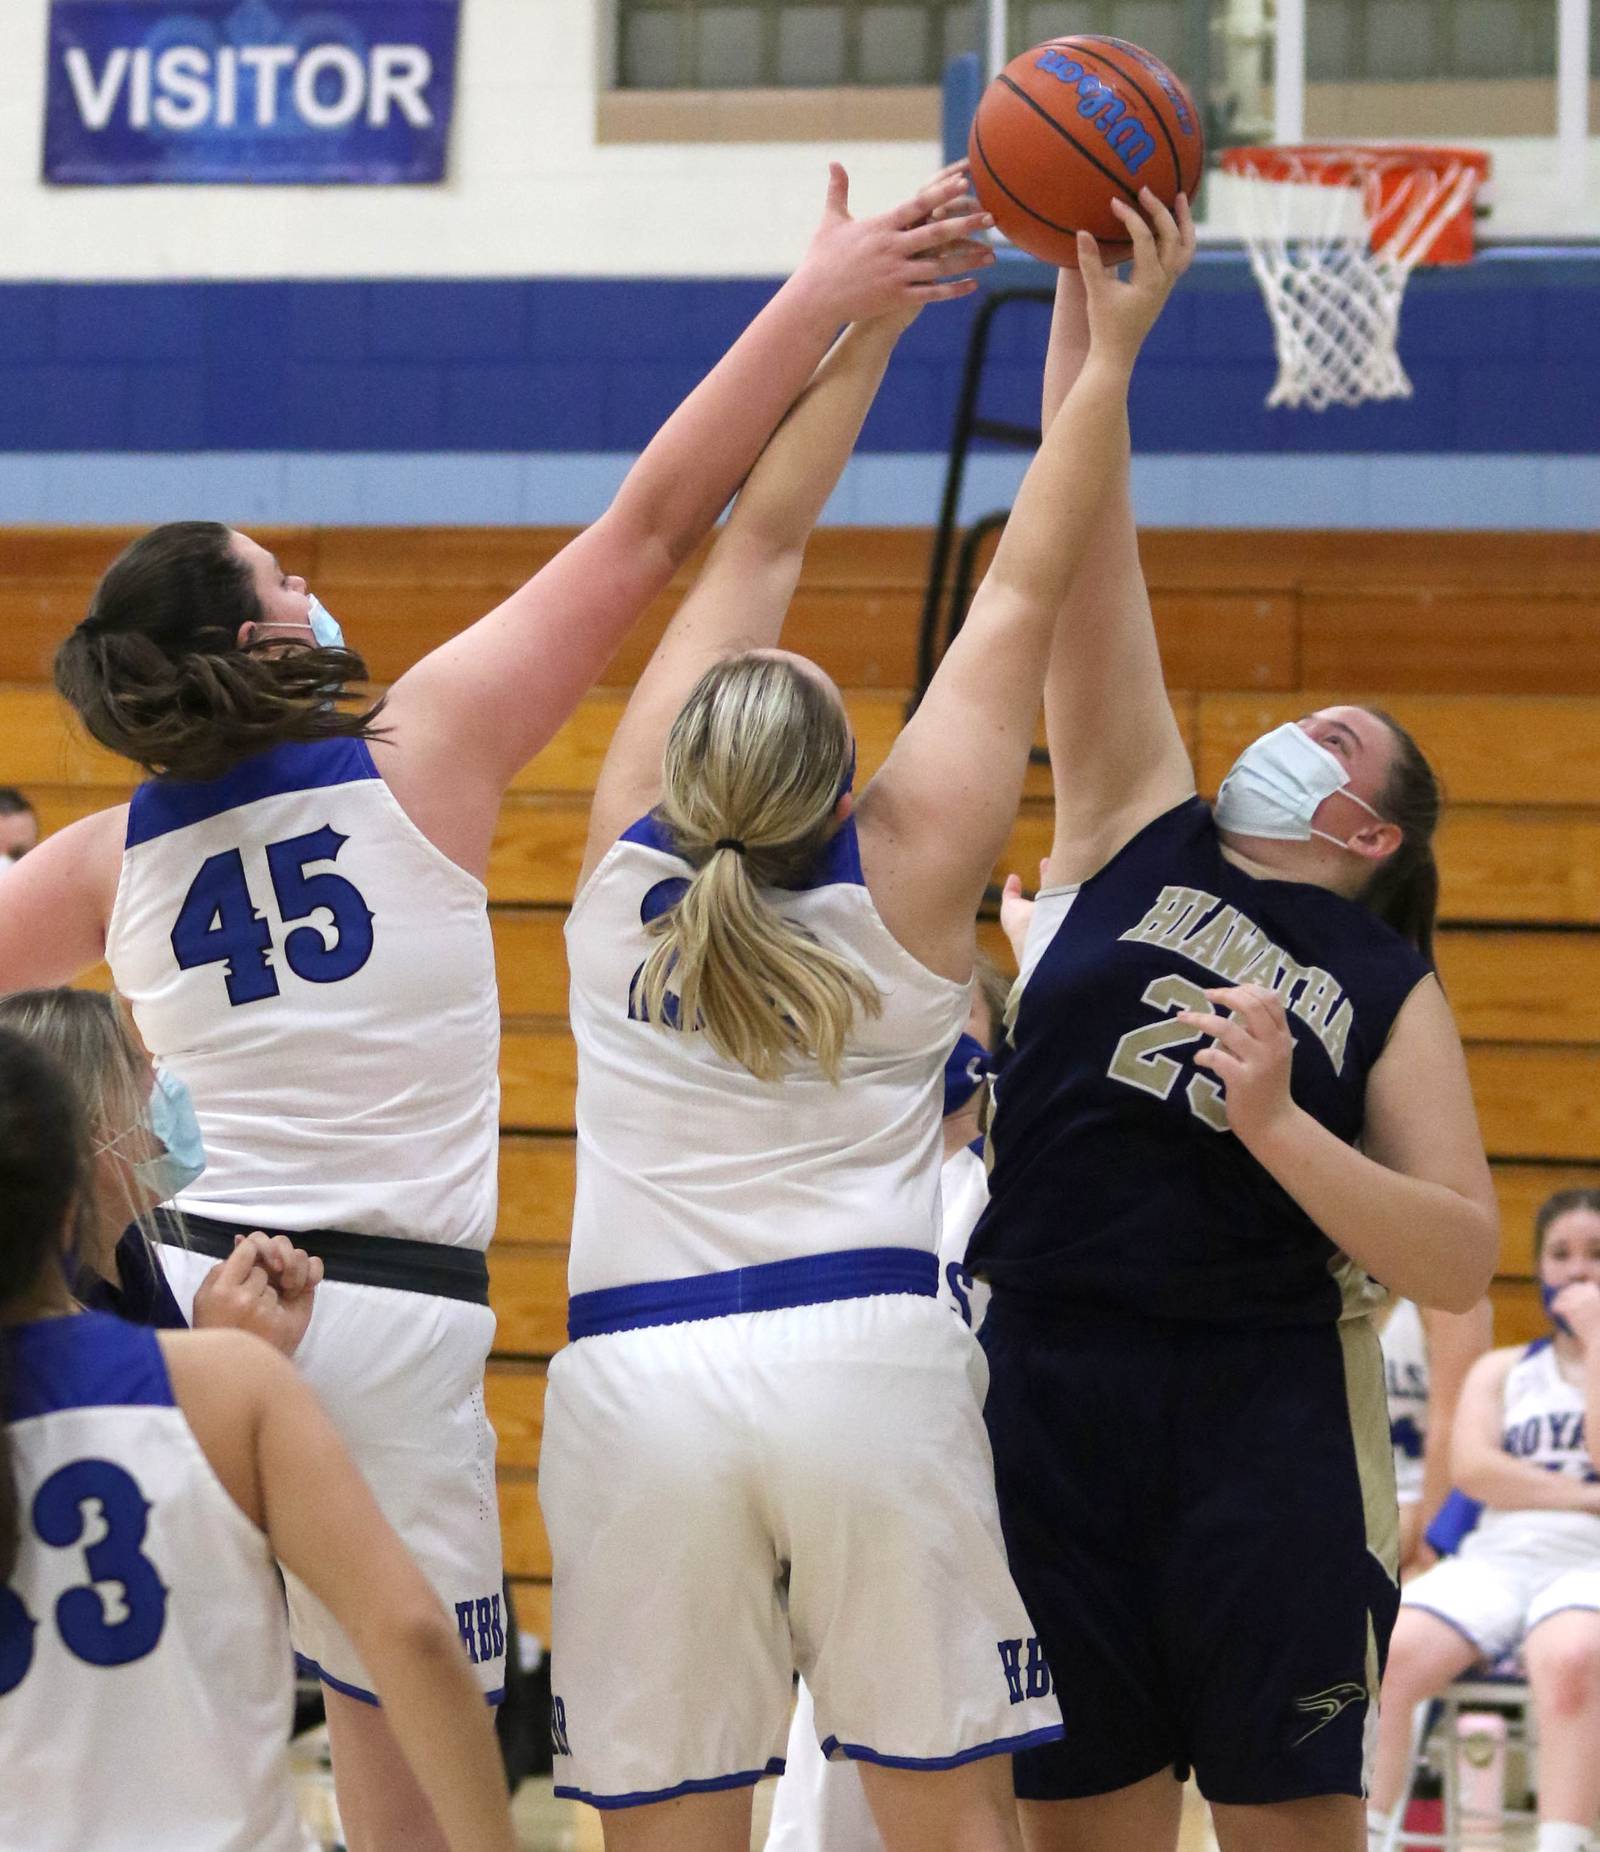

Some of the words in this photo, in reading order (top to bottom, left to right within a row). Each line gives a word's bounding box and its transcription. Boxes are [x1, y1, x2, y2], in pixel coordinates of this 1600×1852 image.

[64, 44, 433, 131] VISITOR
[1035, 50, 1156, 176] Wilson
[170, 823, 376, 1007] 45
[1116, 885, 1355, 1078] HIAWATHA
[455, 1593, 505, 1664] HBB
[997, 1638, 1056, 1705] HB
